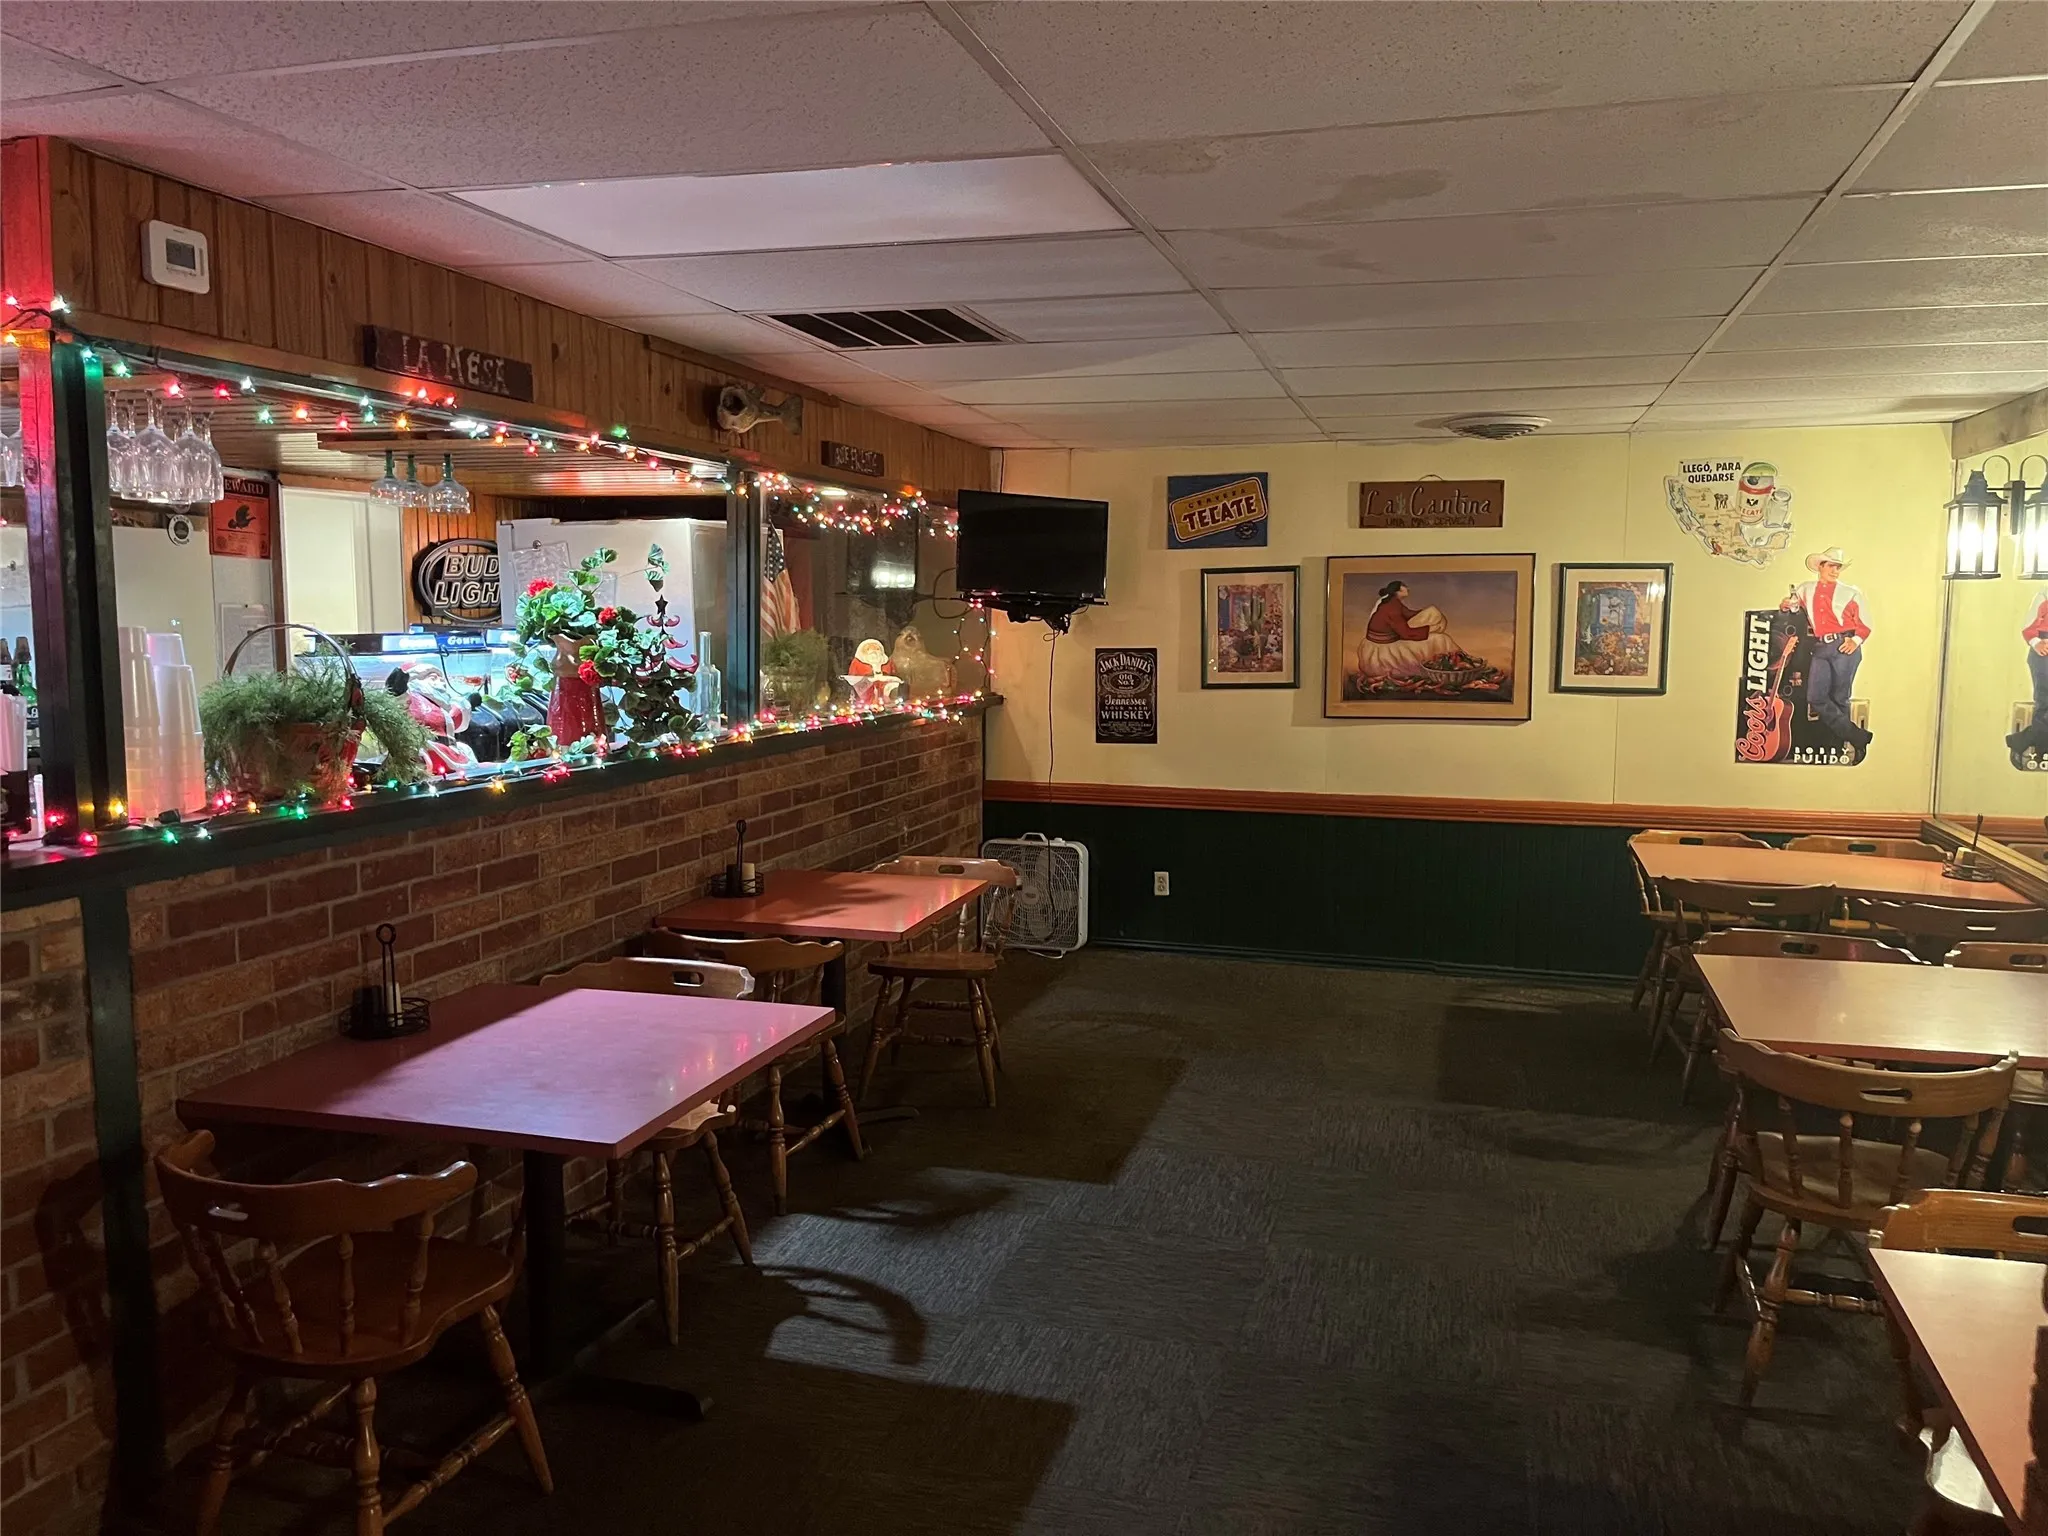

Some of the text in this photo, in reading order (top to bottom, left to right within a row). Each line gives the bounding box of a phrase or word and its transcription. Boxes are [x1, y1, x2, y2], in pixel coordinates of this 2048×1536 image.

[402, 335, 510, 395] LA MESA
[1682, 461, 1741, 473] LLEGÓ, PARA
[224, 478, 264, 495] EWARD
[1688, 473, 1735, 483] QUEDARSE
[1188, 488, 1247, 509] CERVEZA
[1366, 485, 1492, 518] La Cantina
[1182, 494, 1257, 531] TECATE
[444, 554, 500, 579] BUD
[434, 581, 500, 607] LIGH
[1100, 657, 1120, 673] JACK
[1736, 615, 1771, 762] Coors LIGHT
[1101, 710, 1151, 719] WHISKEY
[1794, 754, 1850, 764] PULIDO
